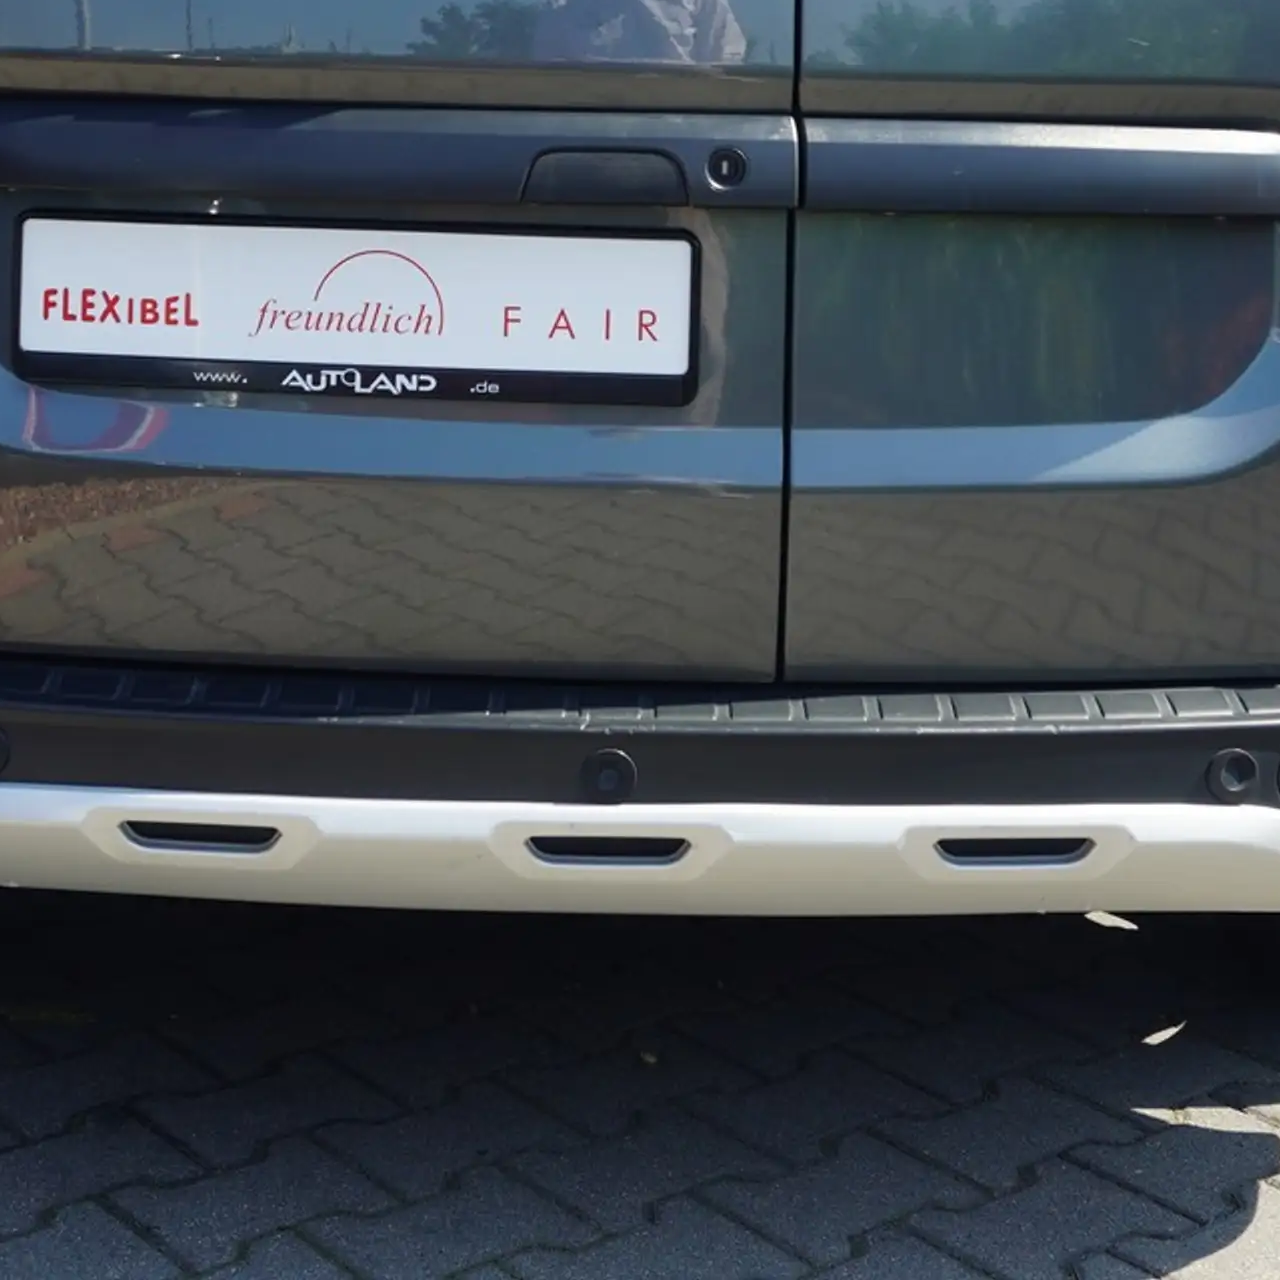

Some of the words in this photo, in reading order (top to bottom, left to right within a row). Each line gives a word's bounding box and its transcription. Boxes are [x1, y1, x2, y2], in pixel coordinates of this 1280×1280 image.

[42, 287, 199, 327] FLEXIBEL
[248, 298, 433, 337] freundlich
[503, 306, 658, 342] FAIR
[193, 370, 248, 384] www.
[281, 368, 437, 394] AUTOLAND
[469, 381, 500, 394] .de
